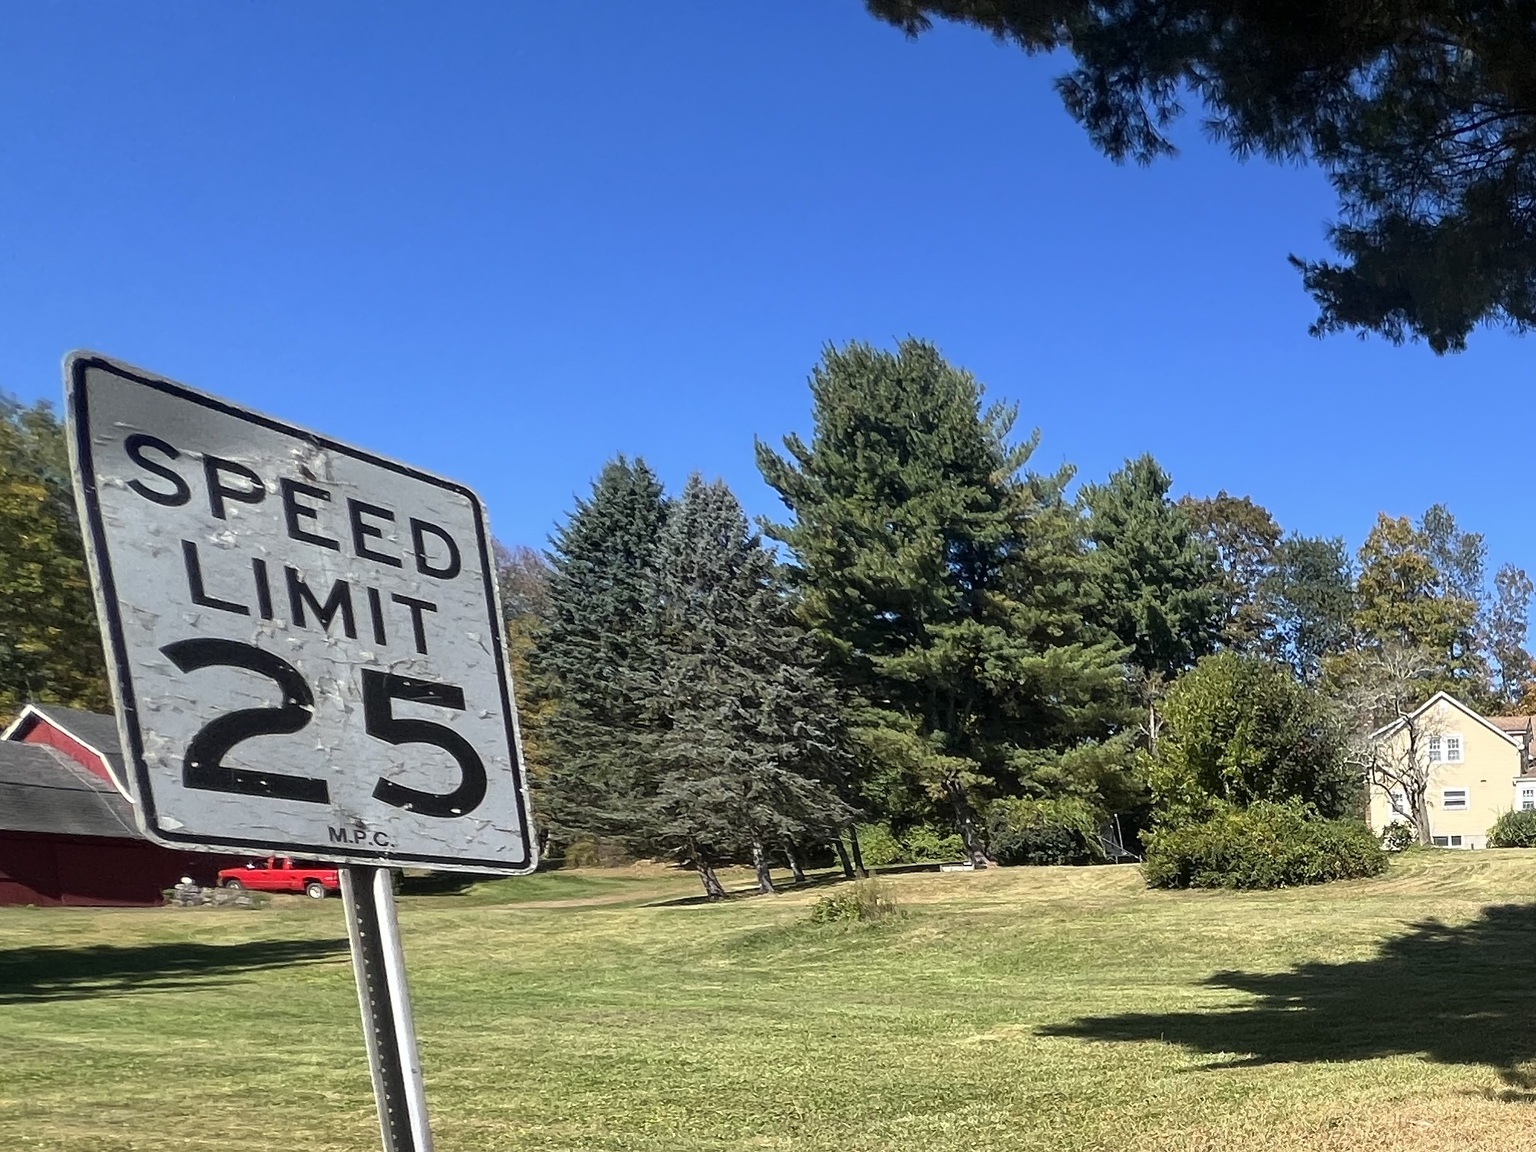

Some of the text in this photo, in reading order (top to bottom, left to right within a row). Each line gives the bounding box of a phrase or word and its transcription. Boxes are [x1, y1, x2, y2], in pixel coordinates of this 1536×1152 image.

[124, 433, 462, 580] SPEED
[181, 539, 438, 655] LIMIT
[158, 637, 488, 818] 25
[327, 825, 395, 849] M.P.C.
